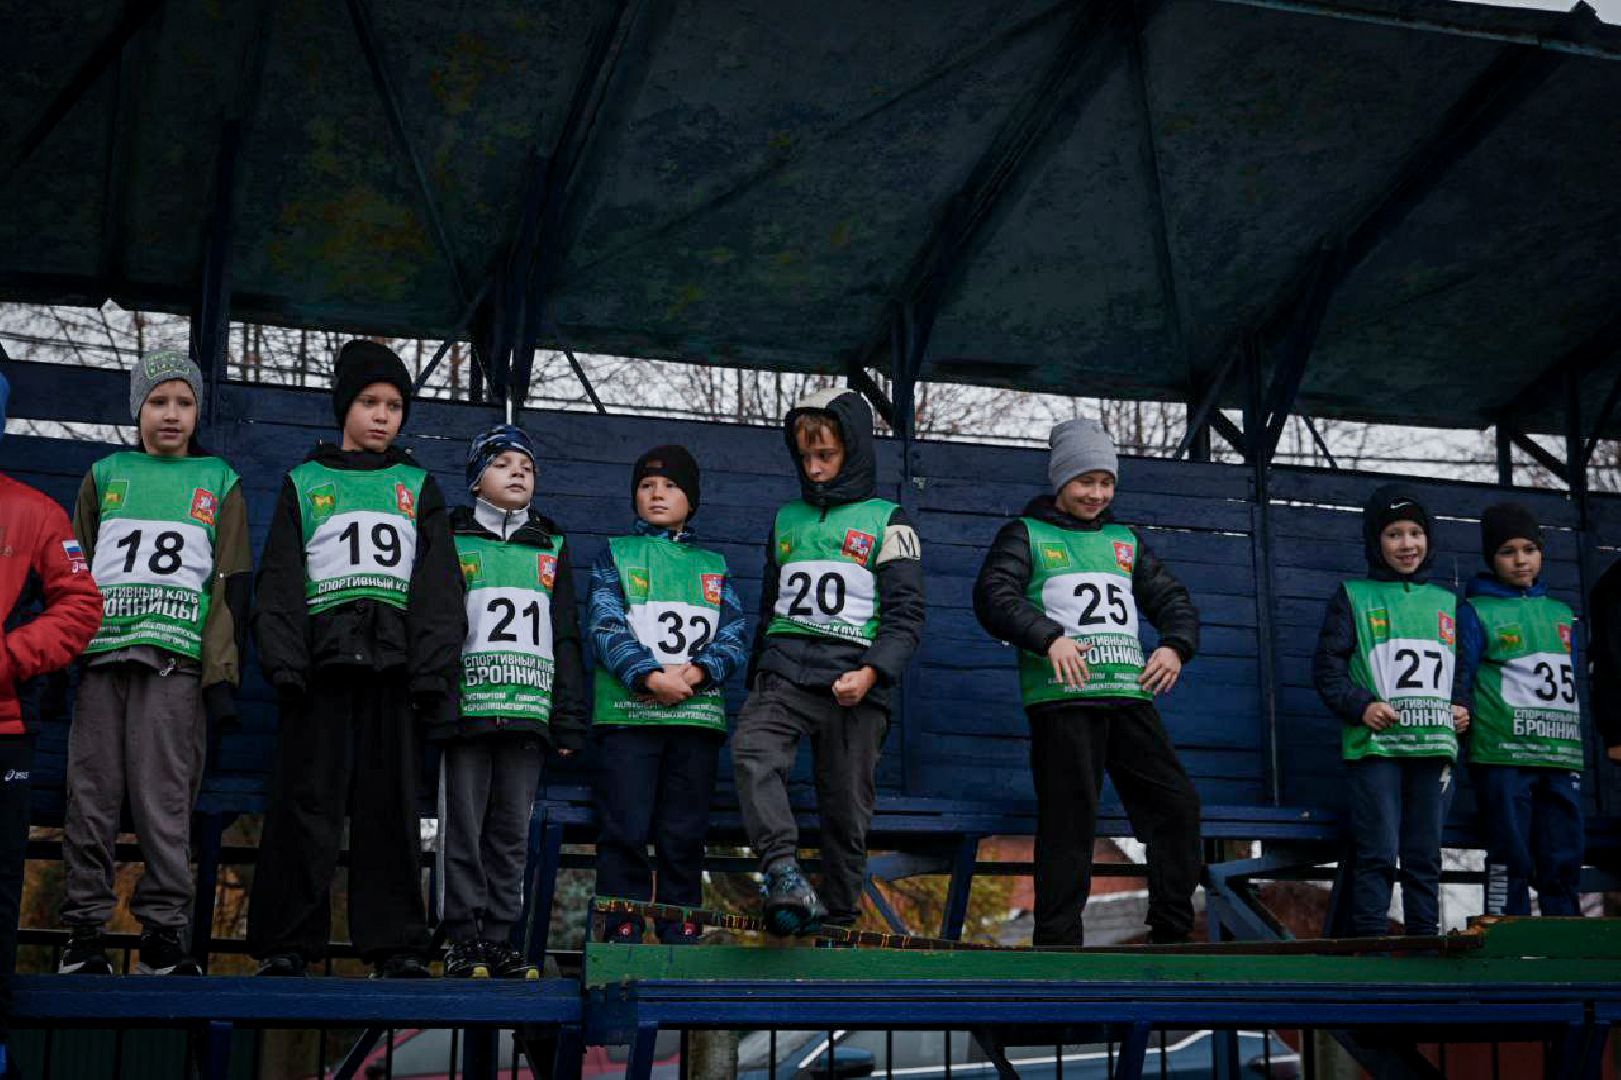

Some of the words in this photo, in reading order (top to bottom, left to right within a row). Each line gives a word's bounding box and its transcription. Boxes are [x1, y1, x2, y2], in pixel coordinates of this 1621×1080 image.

[116, 529, 185, 575] 18
[339, 521, 401, 568] 19
[166, 590, 198, 603] КЛУБ
[318, 576, 394, 593] СПОРТИВНЫЙ
[787, 571, 845, 617] 20
[1072, 582, 1129, 626] 25
[102, 597, 198, 622] ОННИЦЫ
[487, 597, 540, 646] 21
[657, 610, 711, 659] 32
[463, 654, 536, 669] СПОРТИВНЫЙ
[1394, 648, 1442, 690] 27
[1533, 661, 1575, 704] 35
